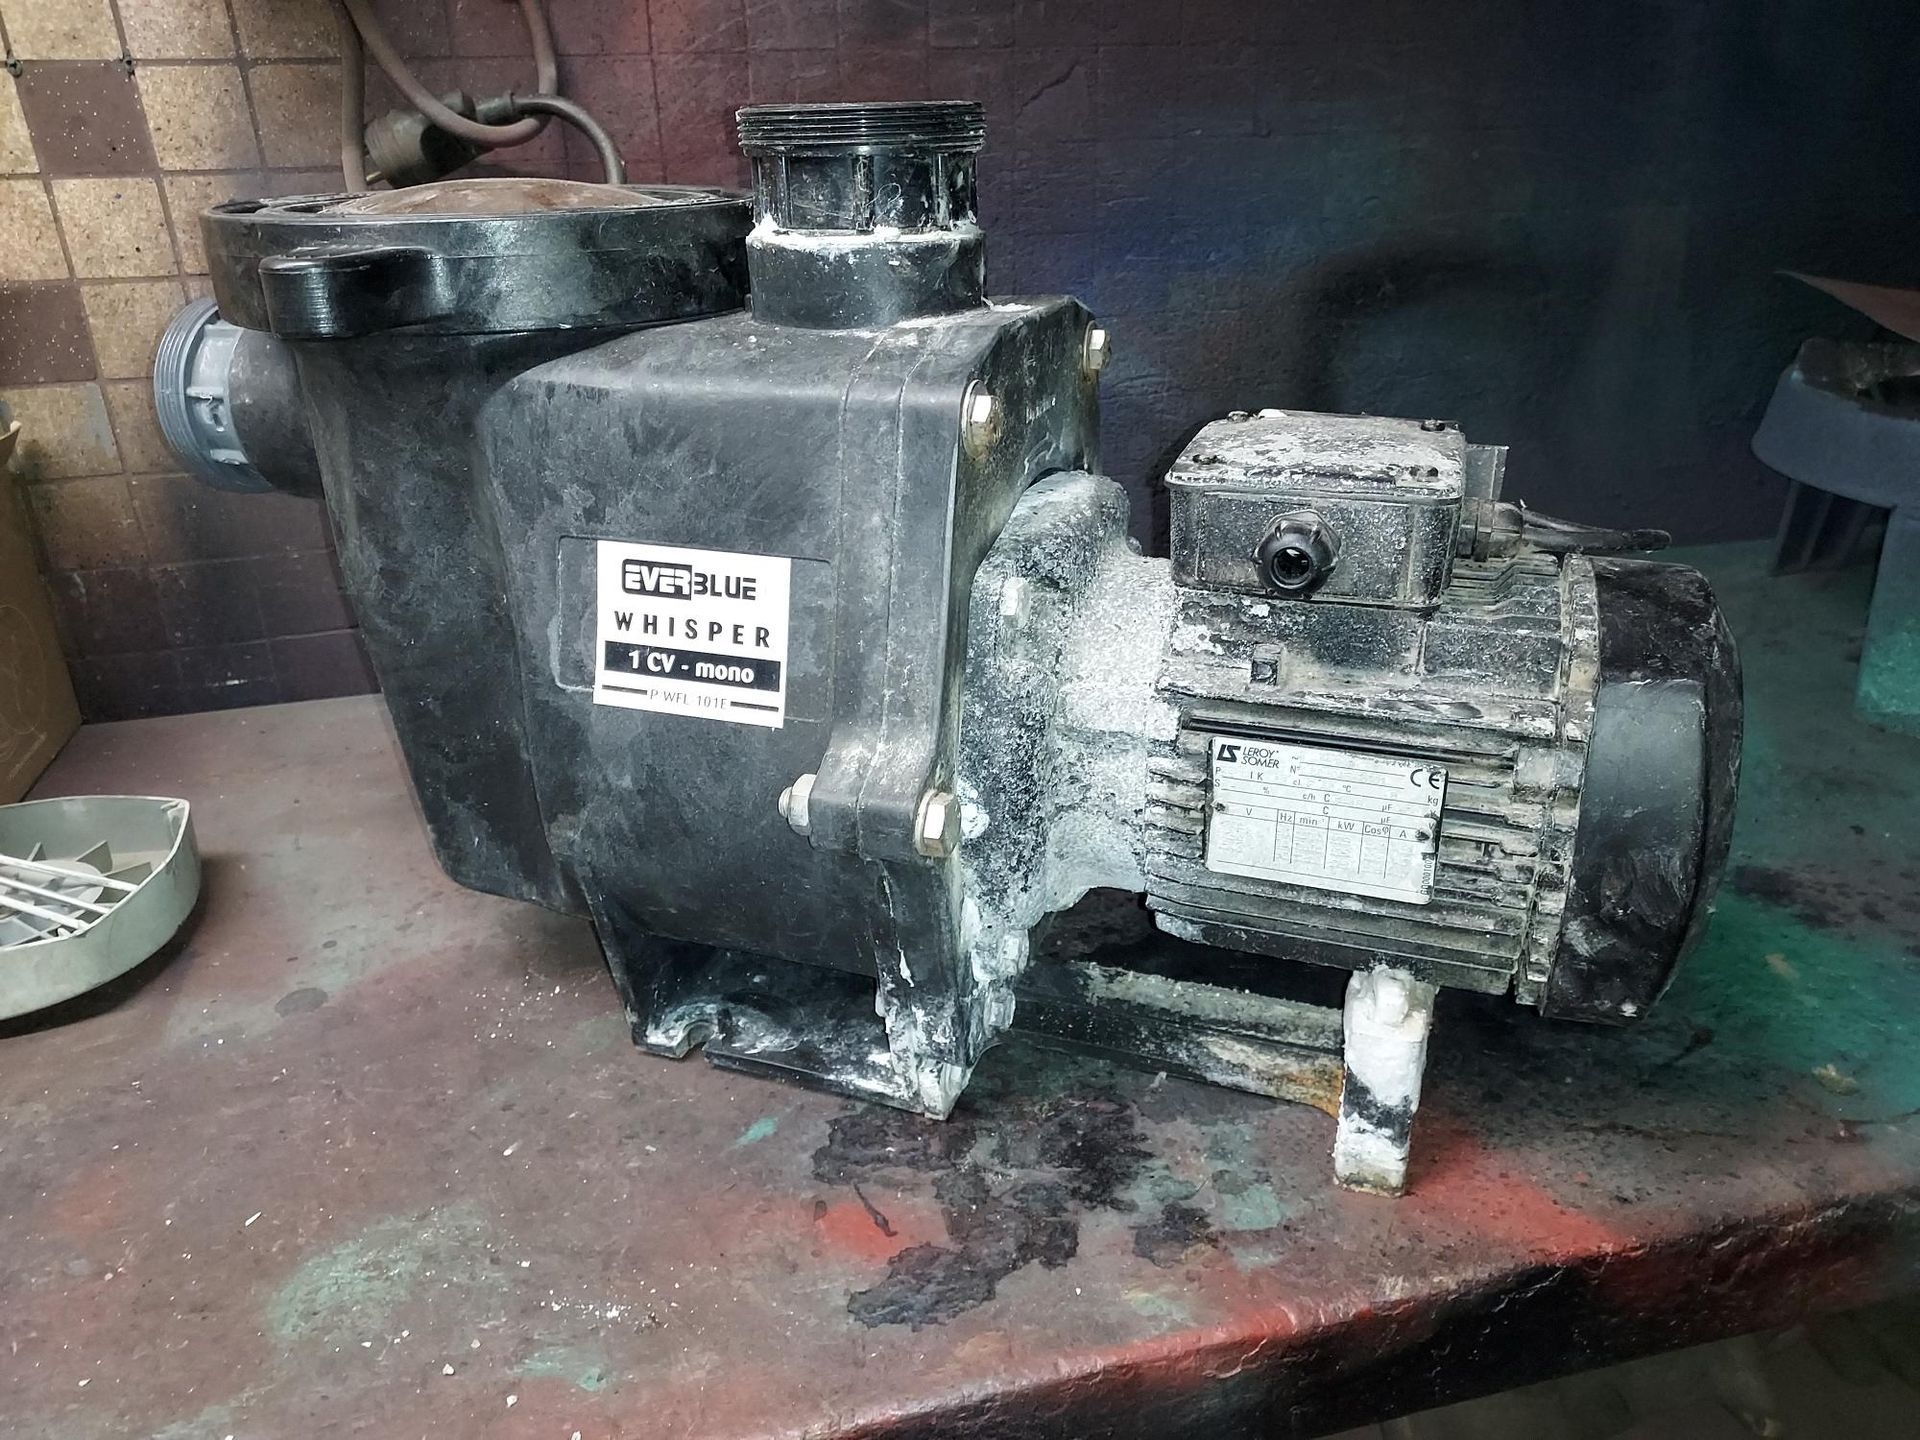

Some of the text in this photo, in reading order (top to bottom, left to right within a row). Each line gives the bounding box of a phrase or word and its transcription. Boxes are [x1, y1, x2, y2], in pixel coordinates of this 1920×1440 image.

[622, 558, 757, 601] EVERBLUE
[614, 610, 770, 648] WHISPER
[628, 649, 640, 669] 1
[646, 652, 675, 673] CV
[695, 661, 755, 684] mono
[1242, 746, 1275, 758] LEROY
[1241, 756, 1280, 769] SOMER
[1214, 778, 1221, 788] S
[1323, 793, 1331, 803] C
[1427, 795, 1439, 807] kg
[1246, 807, 1253, 816] V
[1322, 805, 1330, 815] C
[1280, 812, 1293, 822] Hz
[1337, 820, 1355, 831] kW
[1399, 830, 1407, 839] A
